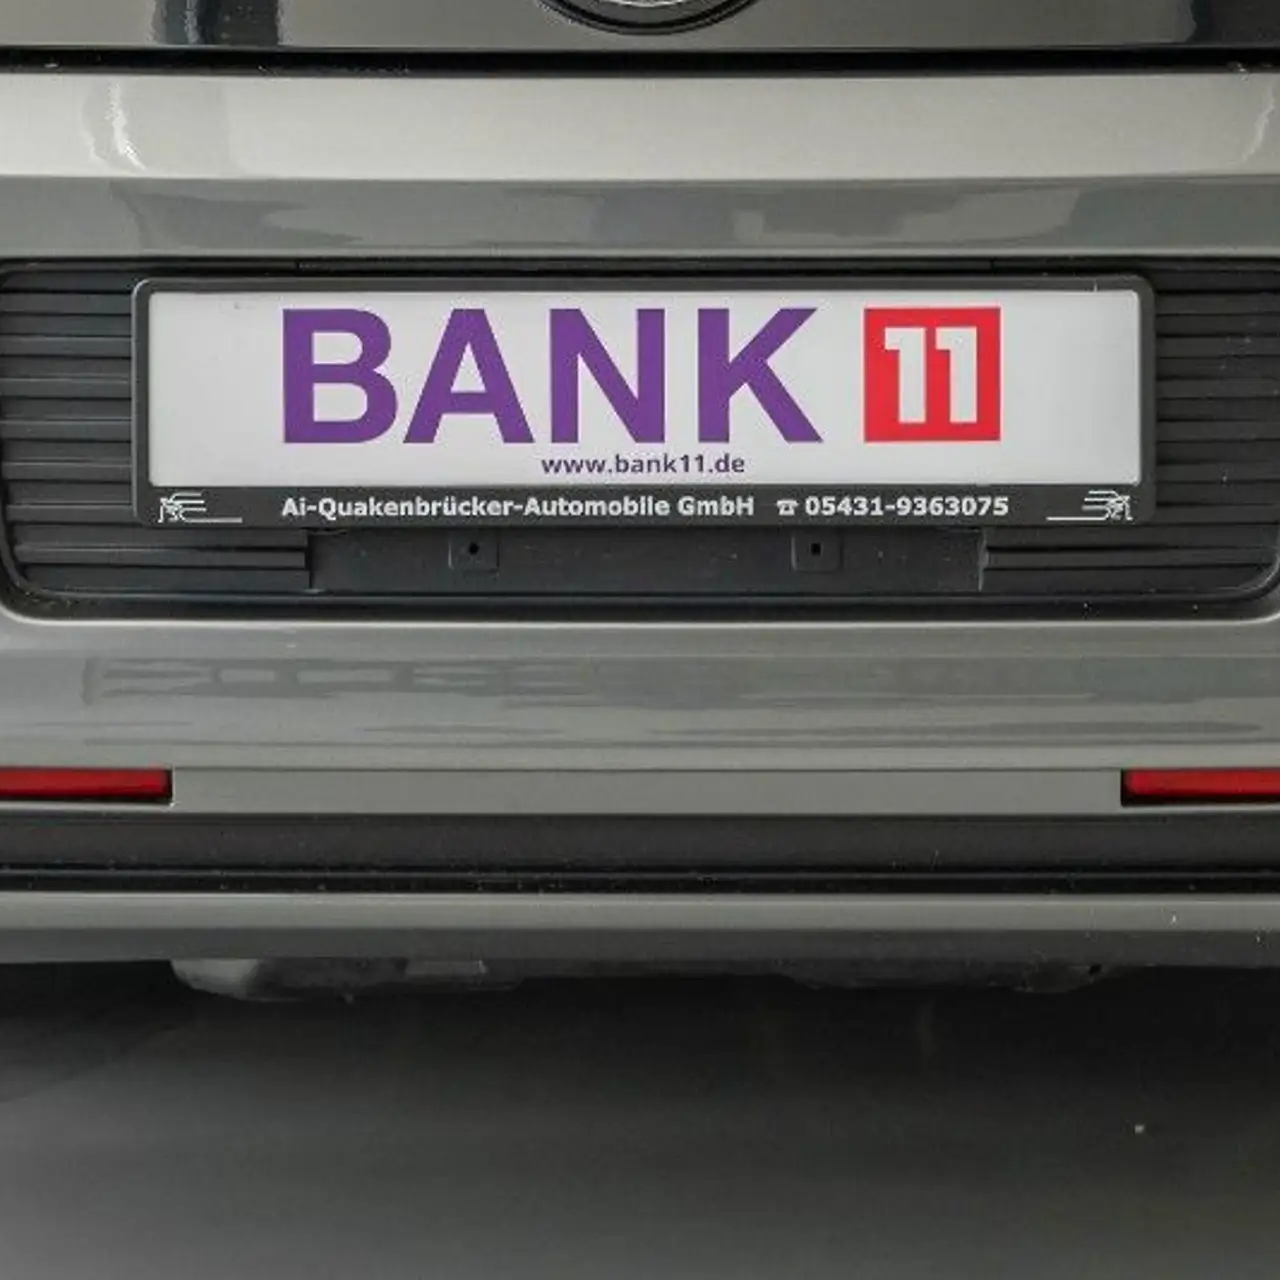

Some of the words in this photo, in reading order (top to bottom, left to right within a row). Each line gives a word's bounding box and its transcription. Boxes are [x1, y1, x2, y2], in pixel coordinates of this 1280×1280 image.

[282, 307, 824, 444] BANK
[880, 322, 982, 428] 11
[541, 452, 746, 474] www.bank11.de
[281, 496, 671, 521] Ai-Quakenbrücker-Automobile
[677, 495, 755, 517] GmbH
[804, 495, 1010, 517] 05431-9363075
